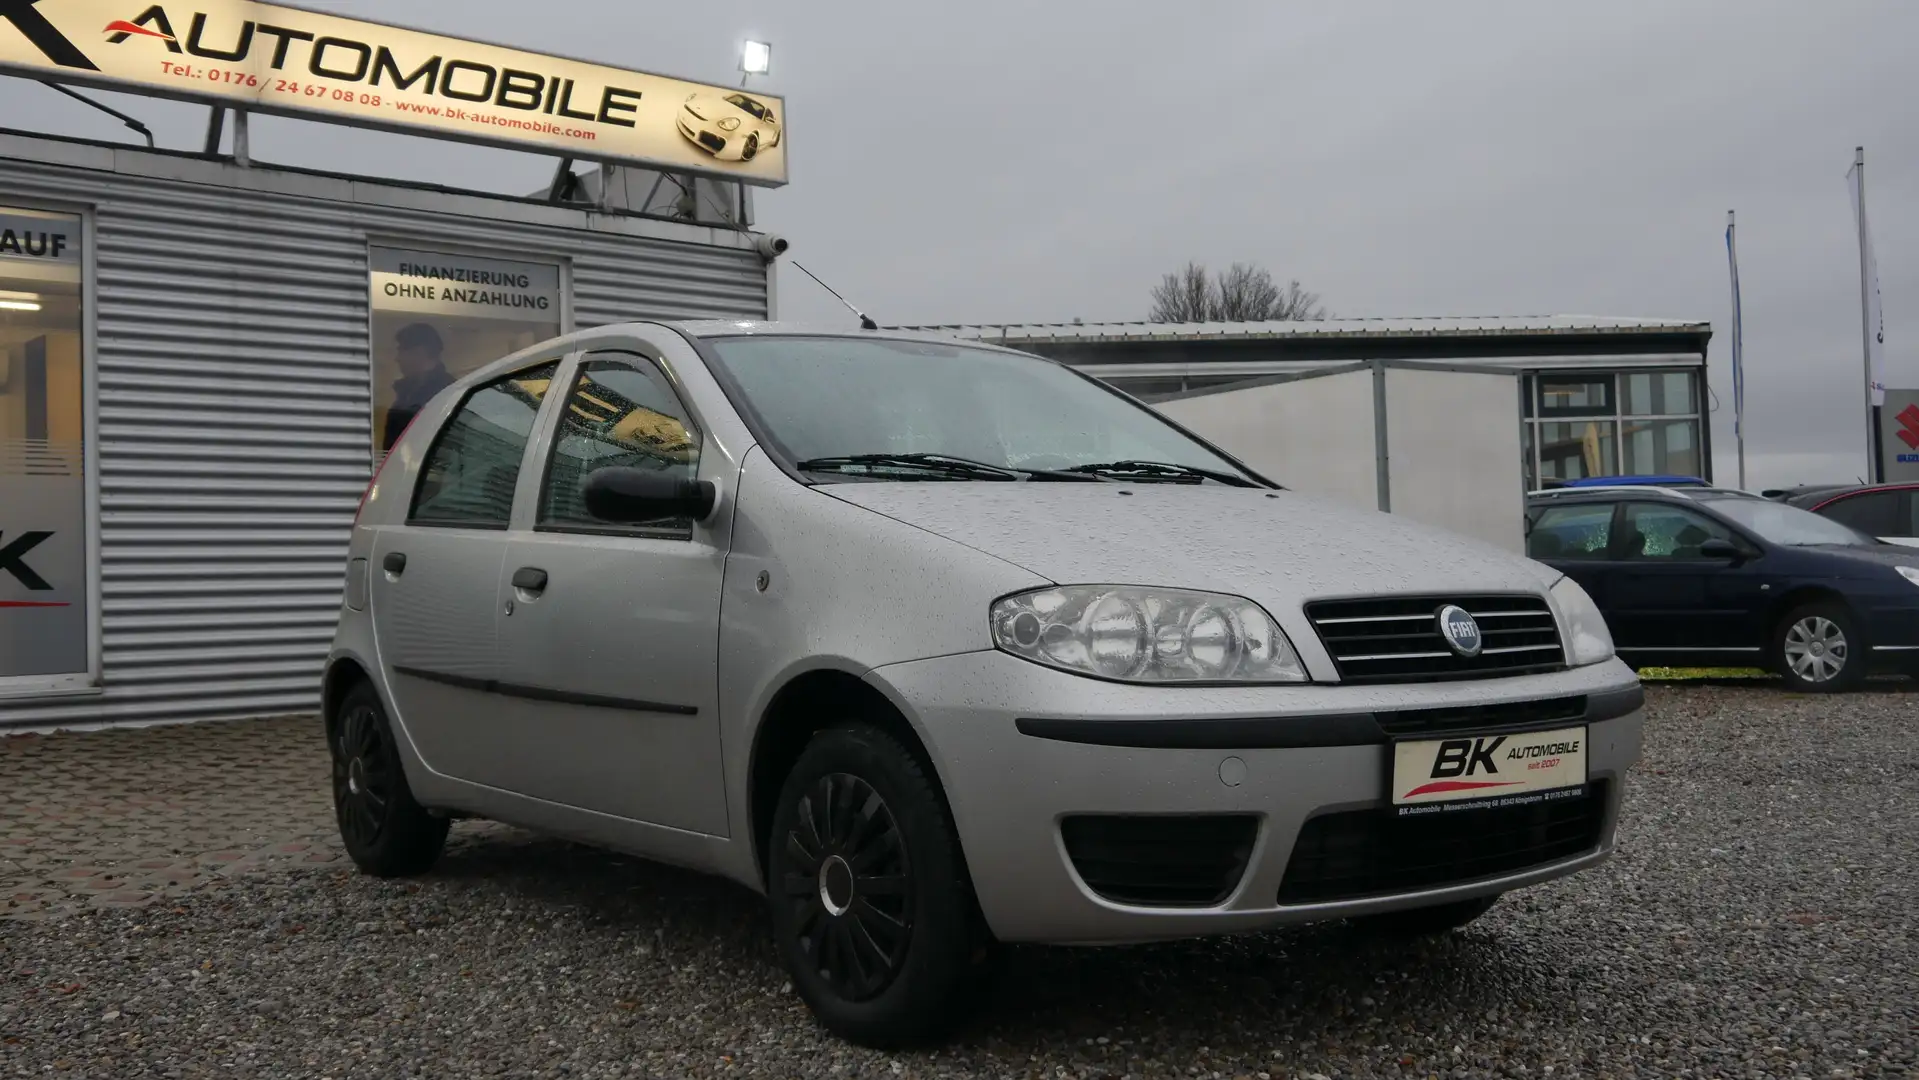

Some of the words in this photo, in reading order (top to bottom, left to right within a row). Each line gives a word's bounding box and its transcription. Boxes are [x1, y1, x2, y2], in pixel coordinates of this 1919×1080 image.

[104, 4, 643, 128] AUTOMOBILE
[160, 61, 202, 79] Tel.:
[207, 68, 257, 88] 0176
[274, 79, 298, 94] 24
[303, 86, 327, 98] 67
[331, 88, 354, 102] 08
[359, 94, 381, 107] 08
[395, 99, 597, 141] www.bk-automobile.com
[399, 262, 530, 289] FINANZIERUNG
[383, 282, 436, 300] OHNE
[441, 287, 549, 310] ANZAHLUNG
[1448, 621, 1477, 639] FIAT
[1429, 736, 1509, 779] BK
[1506, 740, 1580, 761] AUTOMOBILE
[1527, 760, 1541, 771] seit
[1541, 758, 1561, 769] 2007
